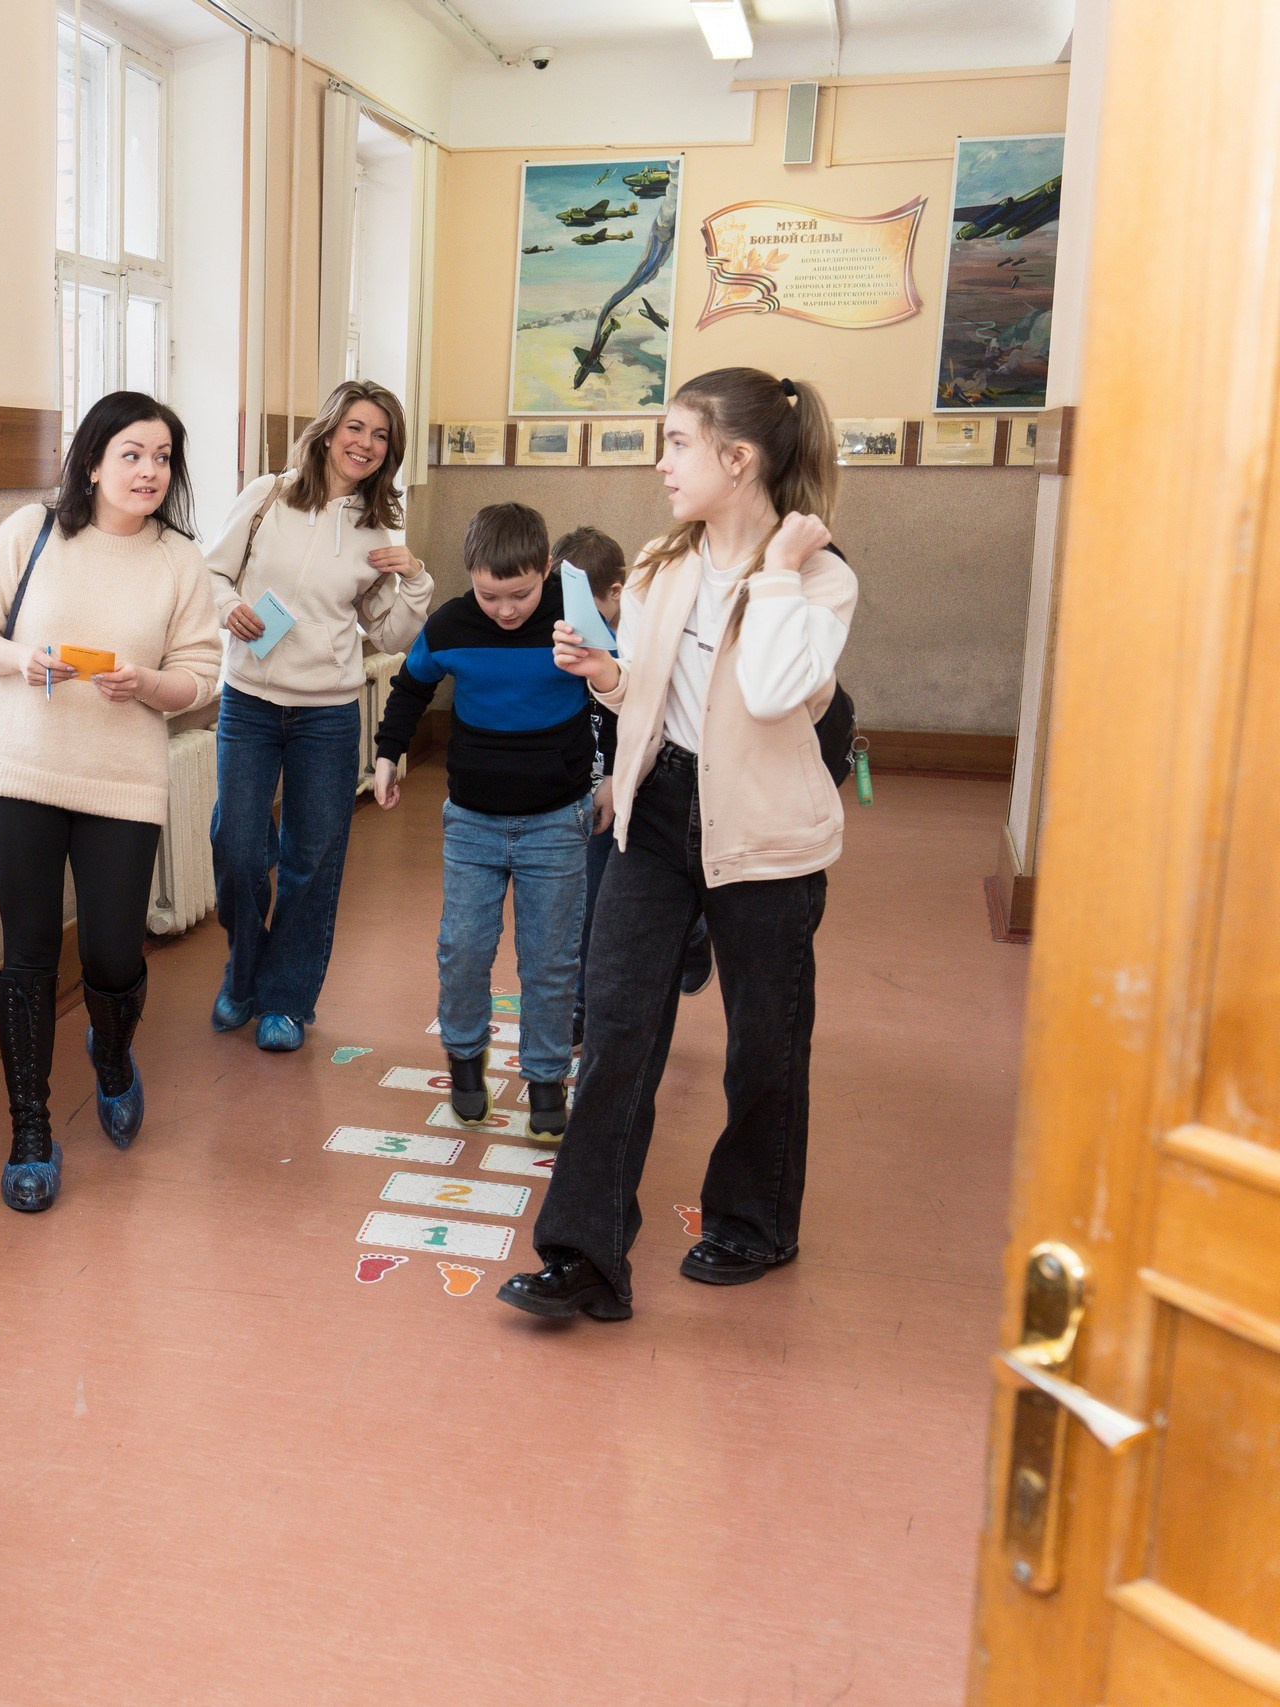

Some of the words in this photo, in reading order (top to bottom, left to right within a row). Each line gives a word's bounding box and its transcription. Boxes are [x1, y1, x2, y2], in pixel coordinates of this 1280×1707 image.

[776, 218, 818, 231] МУЗЕЙ
[750, 232, 798, 245] БОЕВОЙ
[800, 233, 843, 243] СЛАВЫ
[821, 247, 881, 255] ГВАРДЕЙСКОГО
[801, 256, 888, 264] БОМБАРДИРОВОЧНОГО
[855, 272, 891, 280] ОРДЕНОВ
[837, 298, 878, 306] РАСКОВОЙ
[427, 1076, 452, 1088] 6
[484, 1114, 511, 1128] 5
[375, 1136, 412, 1152] 3
[435, 1184, 472, 1204] 2
[422, 1226, 449, 1246] 1
